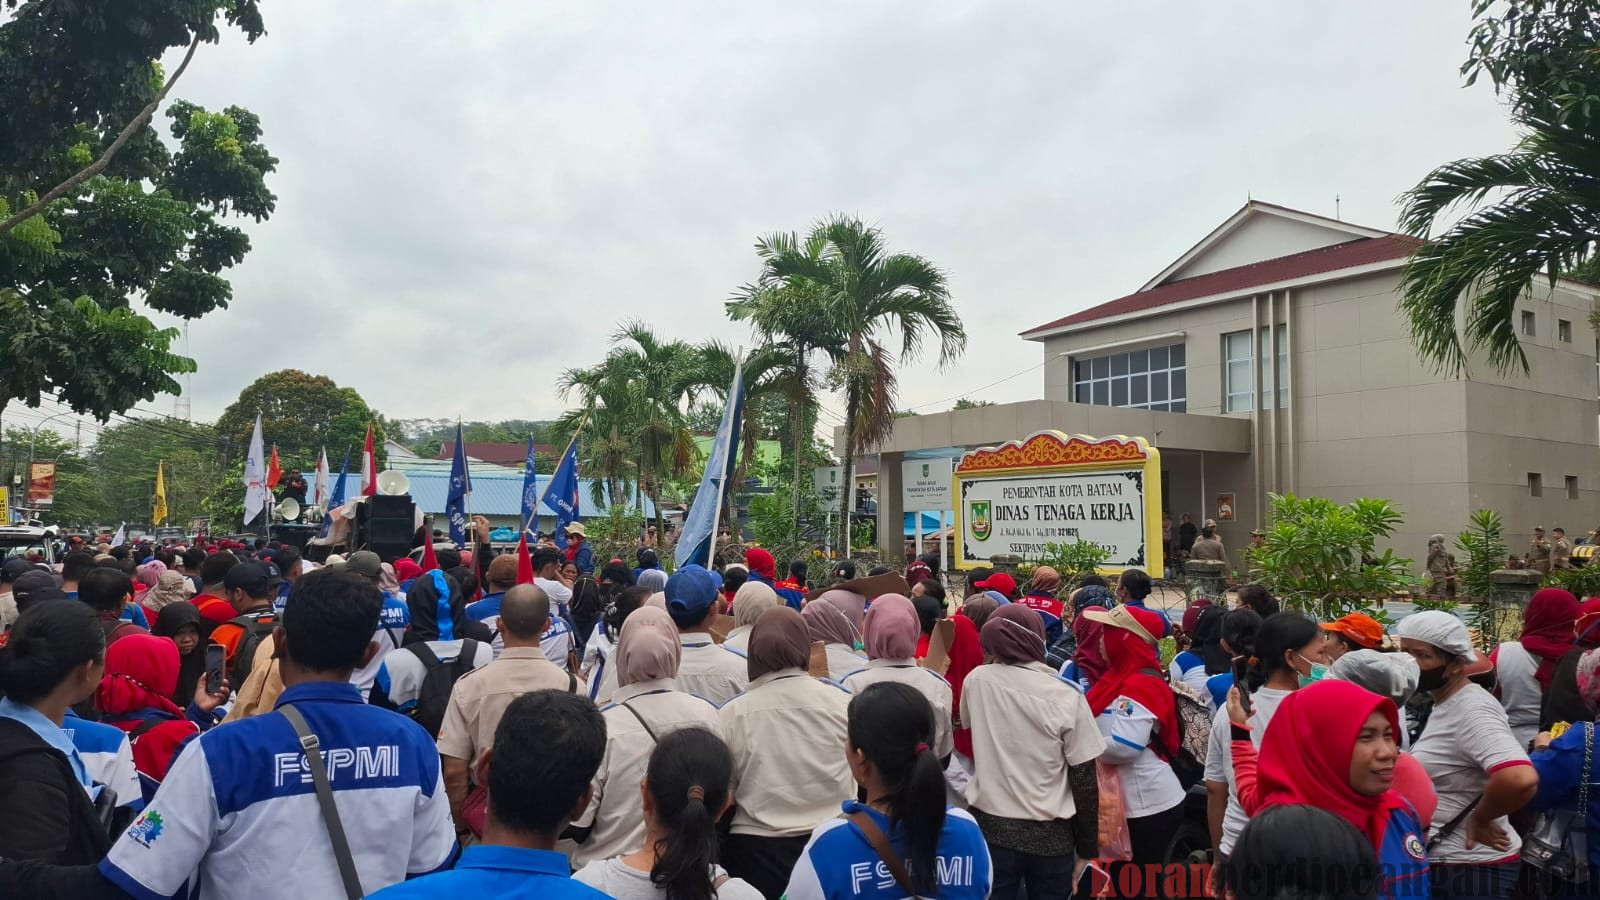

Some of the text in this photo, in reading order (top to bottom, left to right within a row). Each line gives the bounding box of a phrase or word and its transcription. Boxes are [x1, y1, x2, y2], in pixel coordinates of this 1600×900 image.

[1003, 482, 1122, 499] PEMERINTAH KOTA BATAM
[995, 502, 1135, 522] DINAS TENAGA KERJA
[850, 855, 974, 896] FSMI
